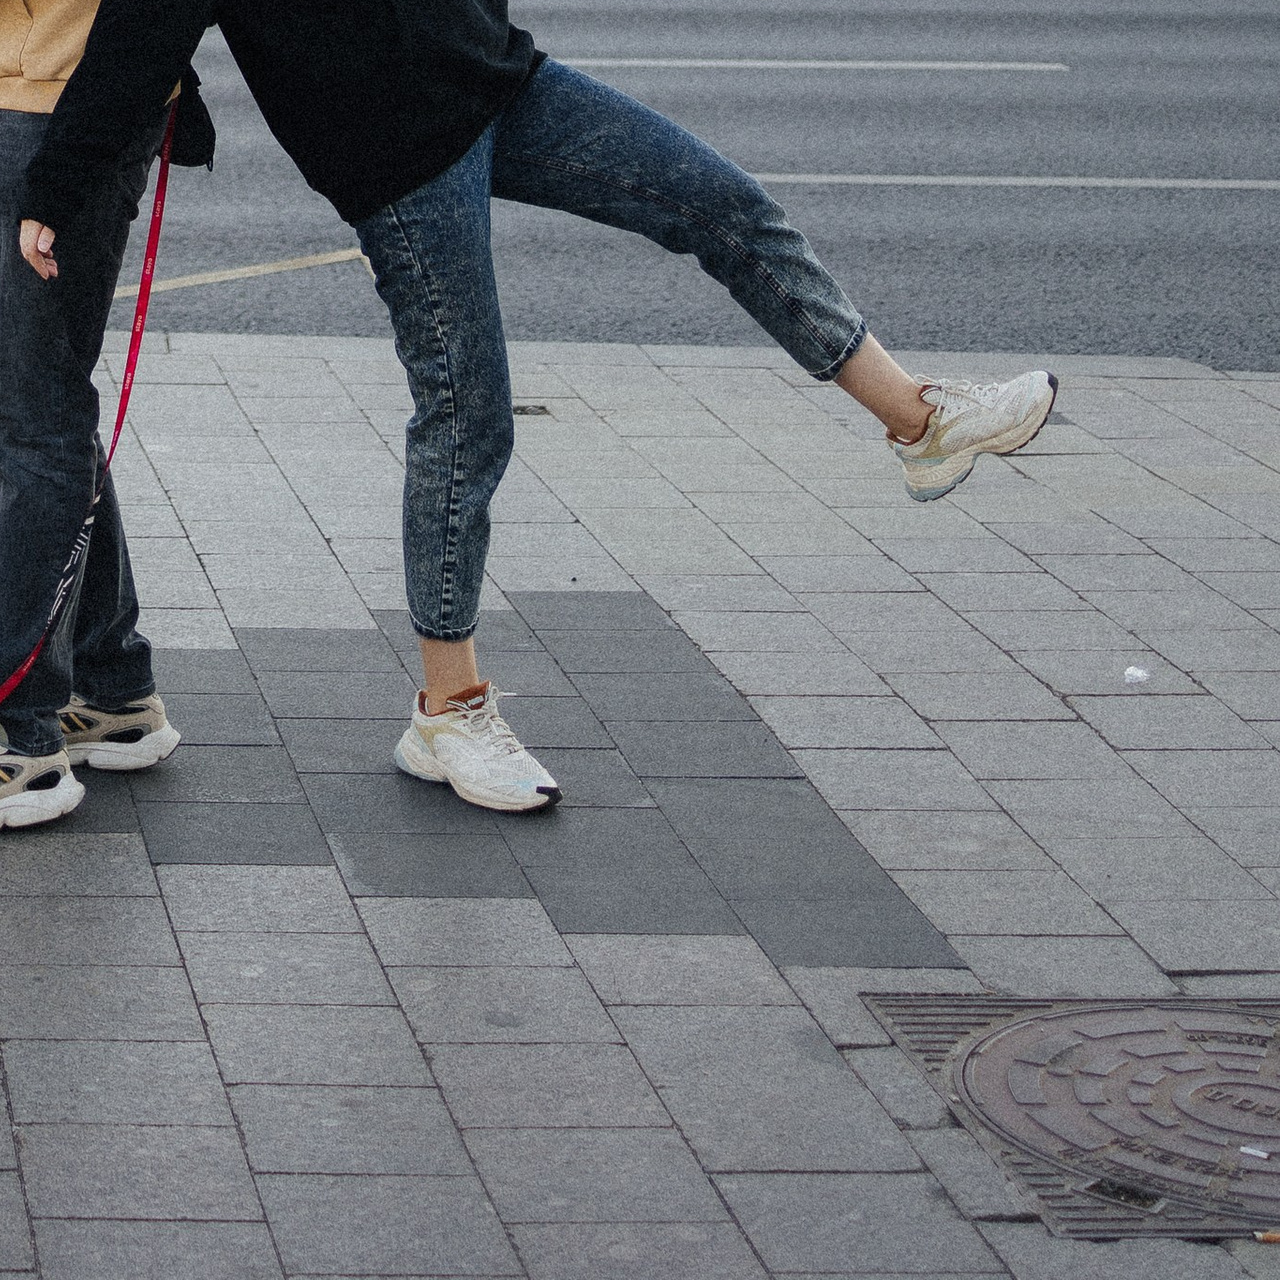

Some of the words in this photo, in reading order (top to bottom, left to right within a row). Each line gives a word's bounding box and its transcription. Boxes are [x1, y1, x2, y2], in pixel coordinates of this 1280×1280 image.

[145, 257, 153, 275] staya
[135, 315, 143, 332] staya
[124, 372, 132, 390] staya
